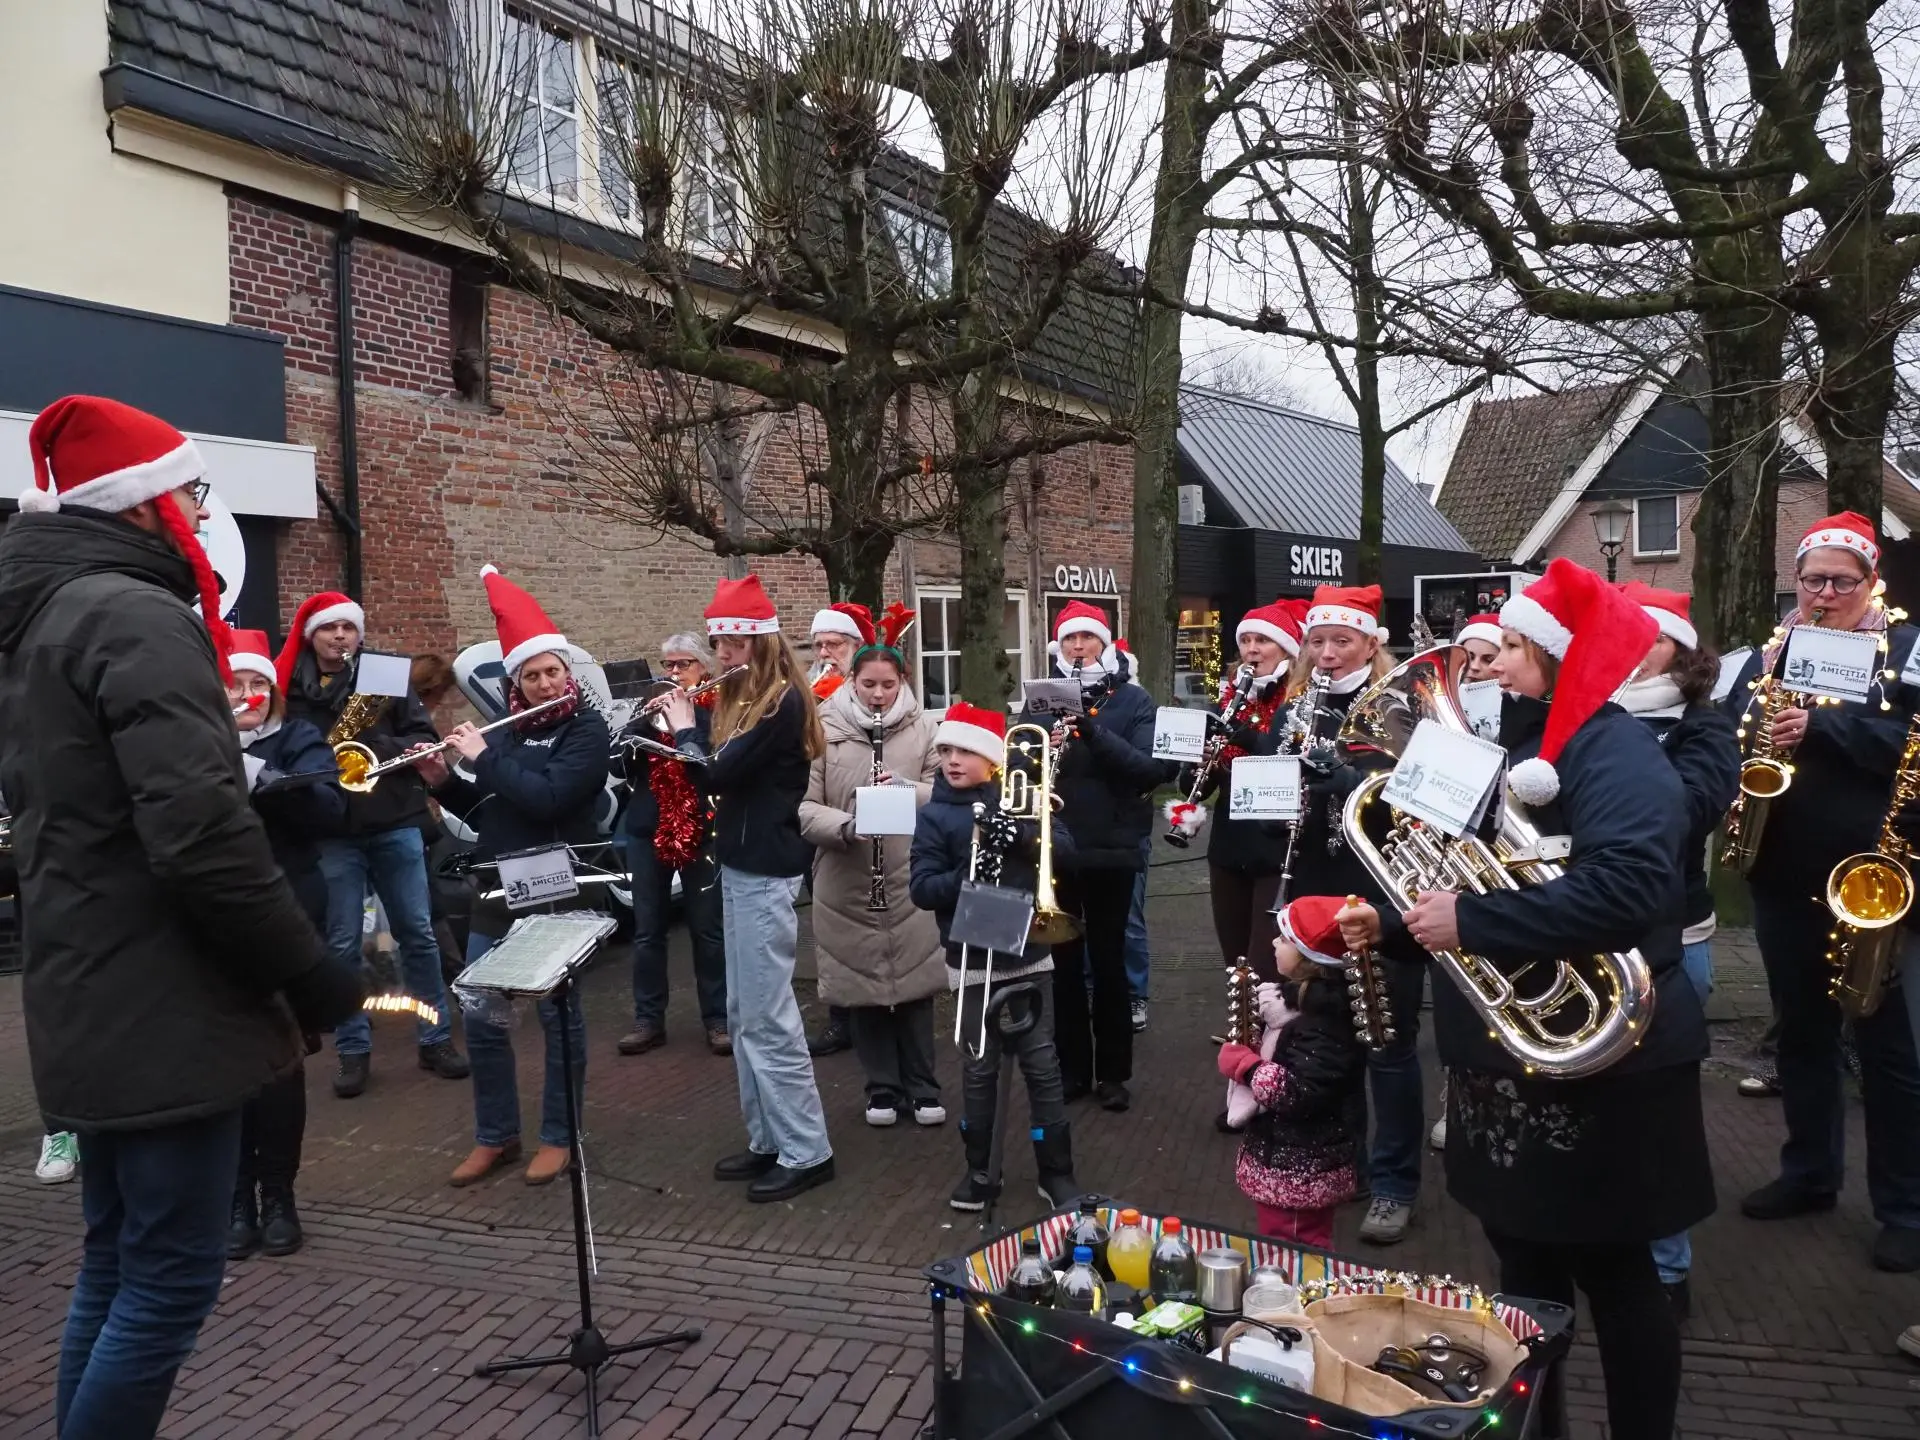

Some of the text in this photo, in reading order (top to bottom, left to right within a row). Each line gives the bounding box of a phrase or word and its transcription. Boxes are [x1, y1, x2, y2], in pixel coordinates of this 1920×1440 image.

[1291, 545, 1343, 577] SKIER
[1055, 564, 1118, 593] OBAIA
[1820, 665, 1867, 678] AMICITIA
[1174, 736, 1202, 744] AMICITIA
[1429, 777, 1475, 803] AMICITIA
[532, 873, 569, 887] AMICITIA
